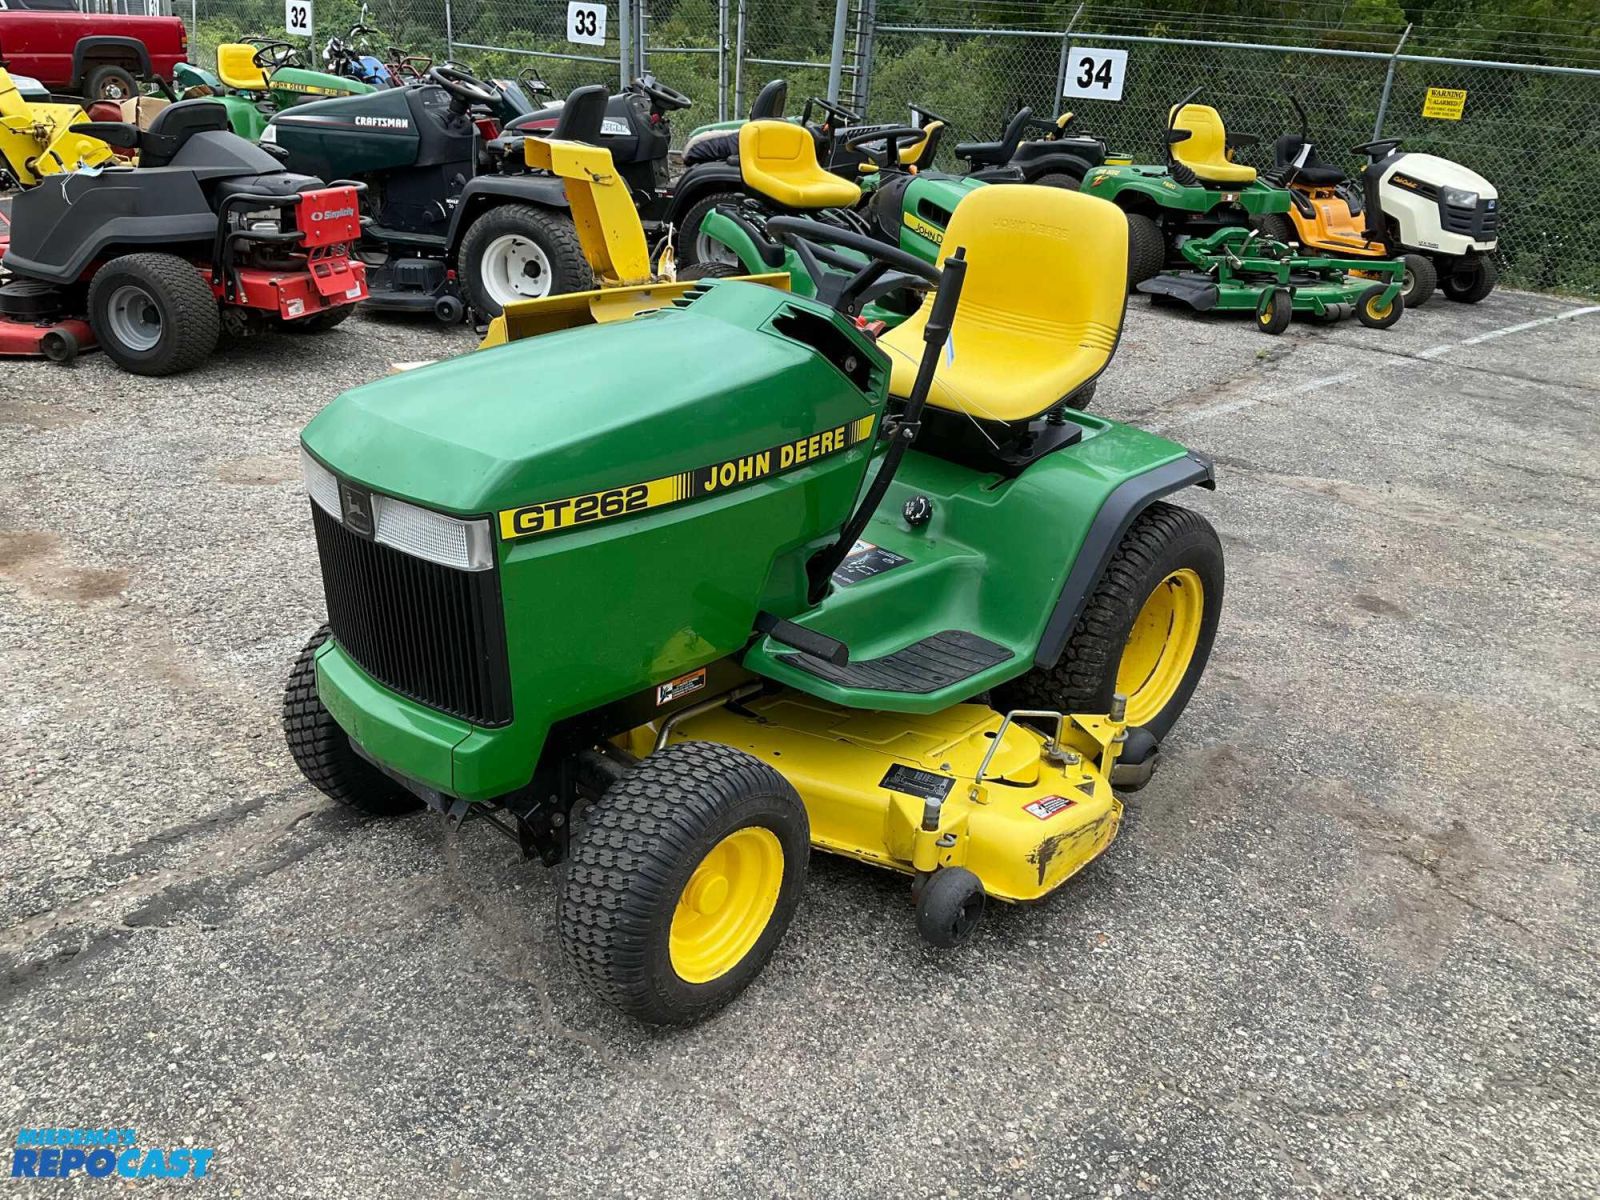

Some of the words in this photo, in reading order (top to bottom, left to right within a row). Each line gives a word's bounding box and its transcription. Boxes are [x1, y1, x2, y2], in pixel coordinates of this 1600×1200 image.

[291, 6, 307, 28] 32
[575, 9, 597, 36] 33
[1077, 56, 1113, 90] 34
[1431, 90, 1464, 98] WARNING
[355, 116, 409, 128] CRAFTSMAN
[915, 223, 937, 241] JOHN
[992, 217, 1027, 232] JOHN
[1030, 222, 1070, 240] DEERE
[704, 451, 771, 492] JOHN
[780, 426, 845, 470] DEERE
[513, 485, 649, 535] GT262
